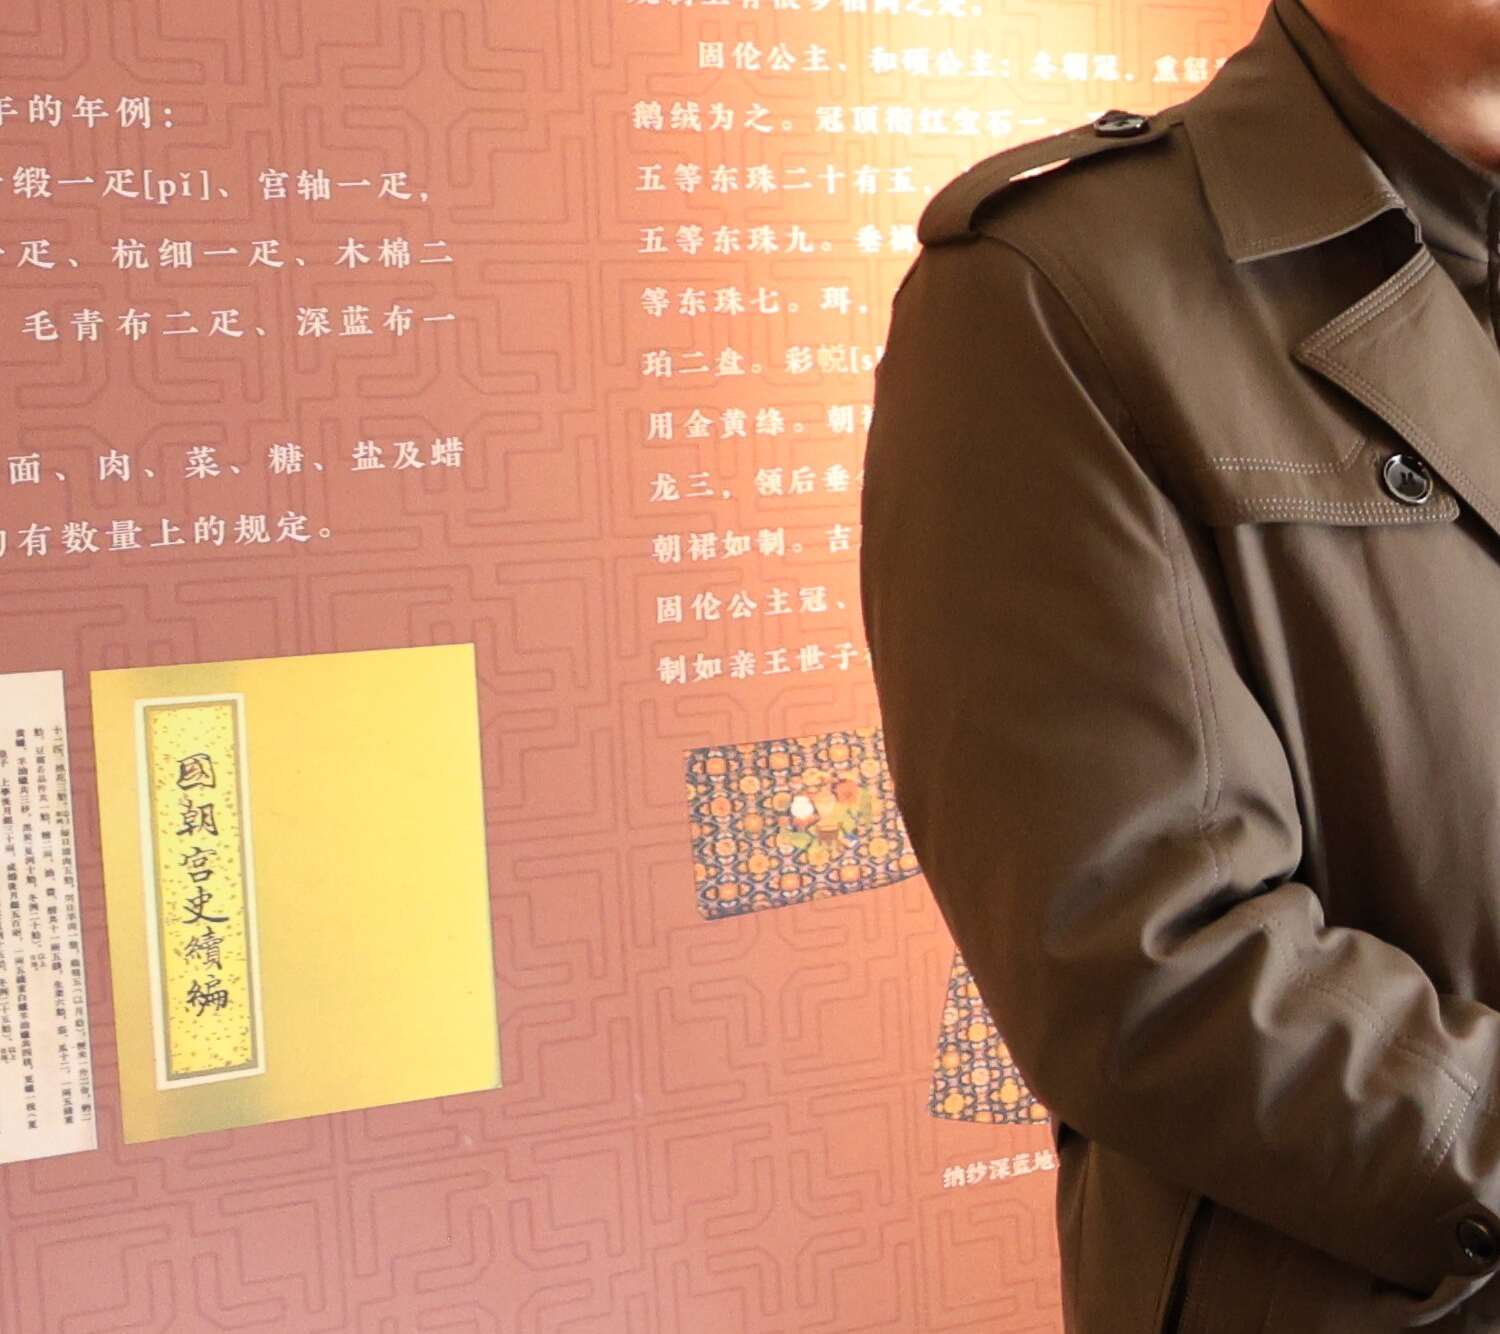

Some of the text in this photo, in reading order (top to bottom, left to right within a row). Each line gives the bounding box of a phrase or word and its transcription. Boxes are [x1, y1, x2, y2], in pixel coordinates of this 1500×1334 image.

[698, 40, 1228, 84] 固伦公主、和硕公主：冬朝冠，熏貂
[0, 166, 429, 207] 缎一疋[pǐ]、宫轴一疋，
[0, 237, 454, 270] 疋、杭细一疋、木棉二
[21, 304, 457, 342] 毛青布二疋、深蓝布一
[649, 463, 865, 503] 龙三，领后垂
[0, 512, 333, 558] 有数量上的规定。
[656, 585, 846, 624] 固伦公主冠、
[657, 641, 872, 686] 制如亲王世子
[943, 1148, 1060, 1188] 纳纱深蓝地
